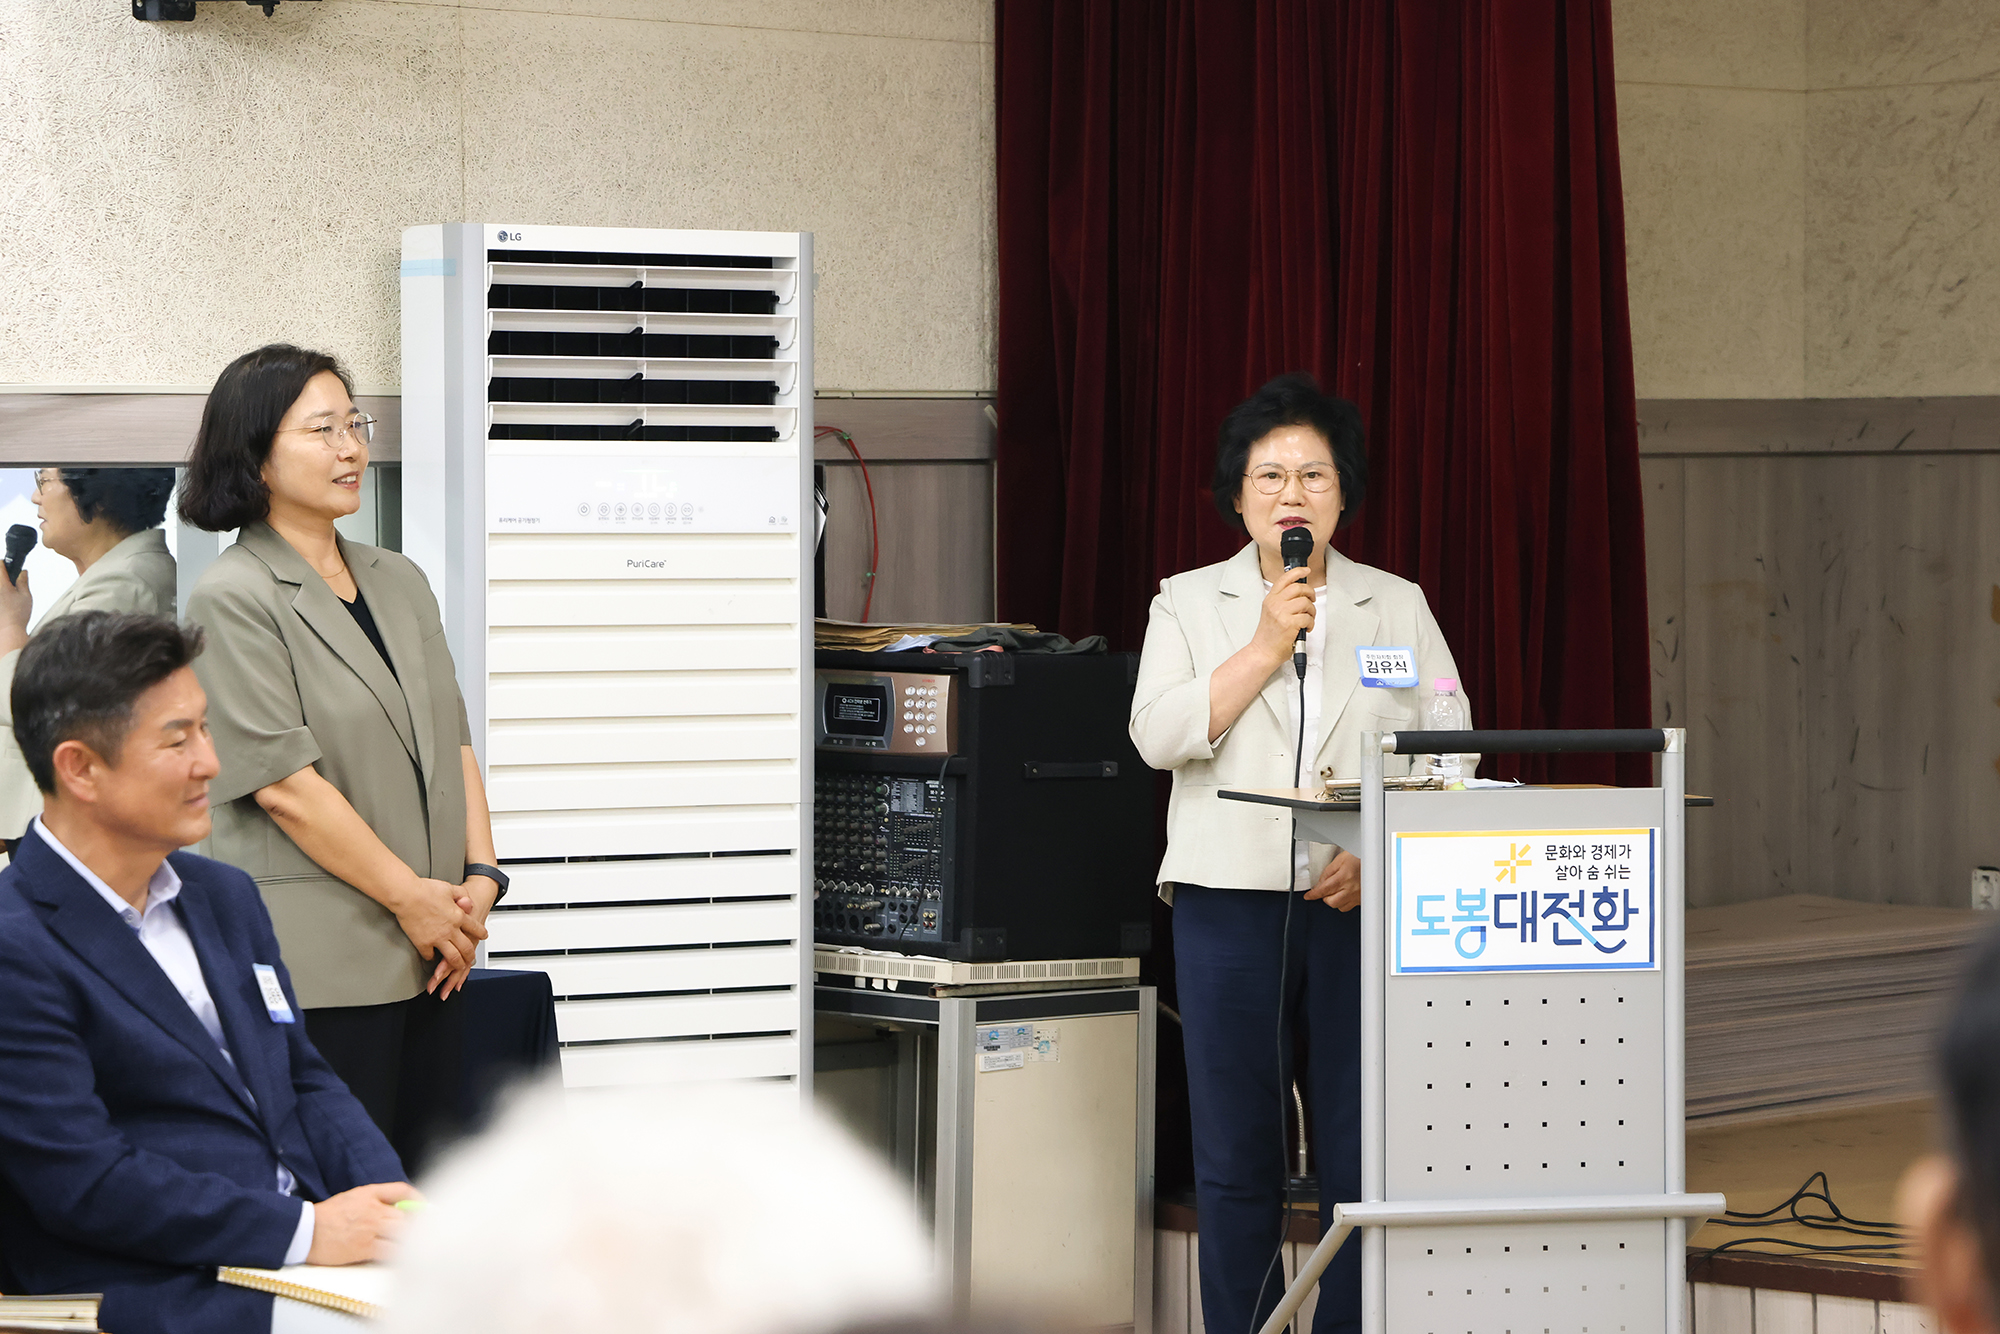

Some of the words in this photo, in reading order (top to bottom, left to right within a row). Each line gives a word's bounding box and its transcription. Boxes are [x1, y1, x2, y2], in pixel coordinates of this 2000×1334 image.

[509, 232, 522, 241] LG
[626, 559, 664, 568] PuriCare
[1366, 660, 1407, 674] 김유식
[1545, 845, 1586, 860] 문화와
[1591, 844, 1631, 860] 경제가
[1555, 865, 1583, 880] 살아
[1587, 865, 1599, 880] 숨
[1604, 864, 1631, 880] 쉬는
[1411, 886, 1639, 959] 도봉대전환
